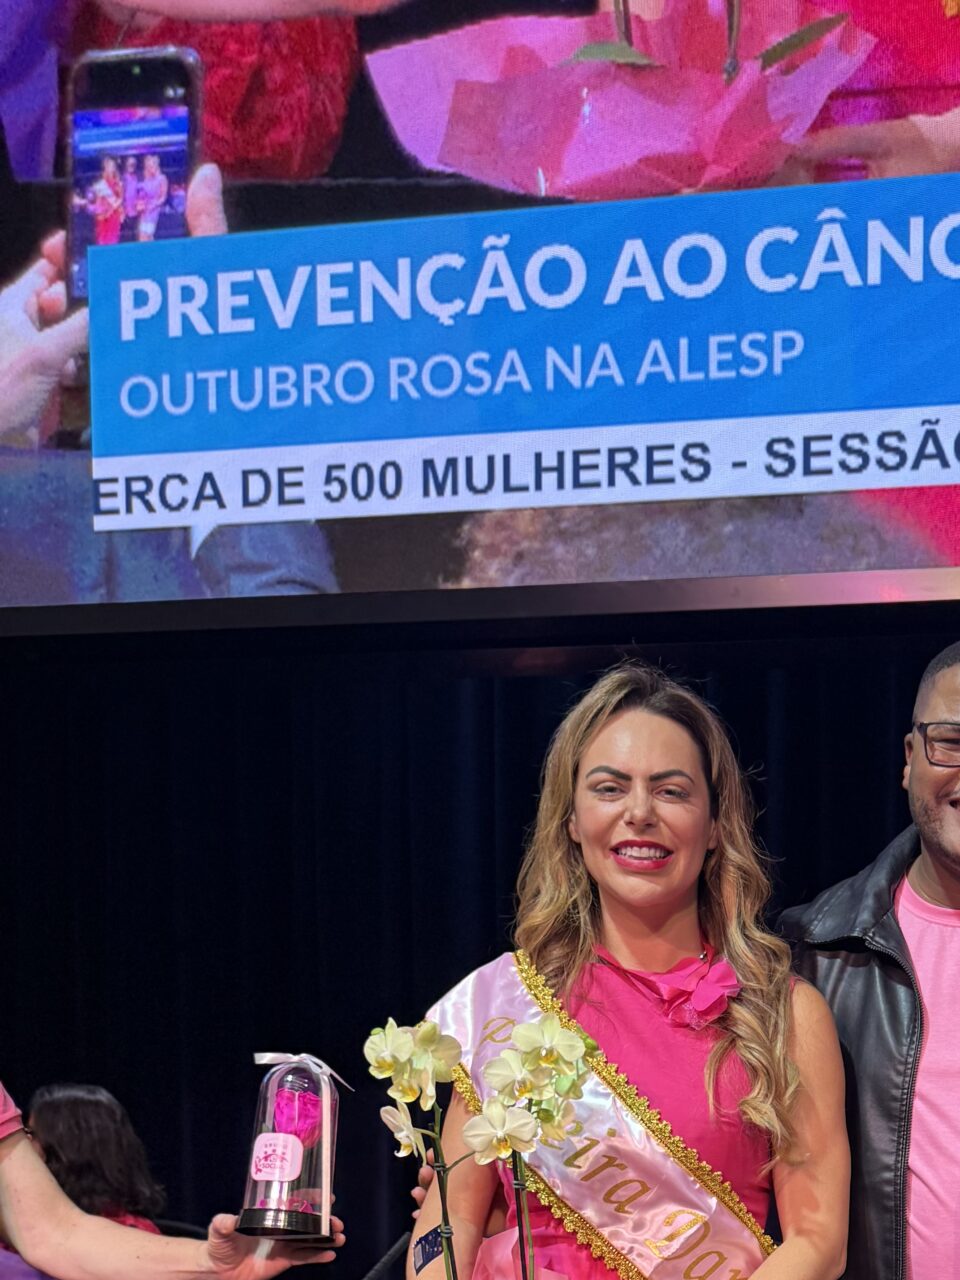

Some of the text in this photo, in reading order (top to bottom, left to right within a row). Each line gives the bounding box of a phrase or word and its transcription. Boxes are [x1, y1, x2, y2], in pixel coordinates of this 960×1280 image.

[119, 234, 587, 341] PREVENÇÃO
[603, 233, 727, 305] AO
[120, 330, 804, 417] OUTUBRO ROSA NA ALESP
[93, 471, 227, 516] ERCA
[241, 466, 306, 508] DE
[323, 460, 403, 503] 500
[422, 442, 712, 499] MULHERES
